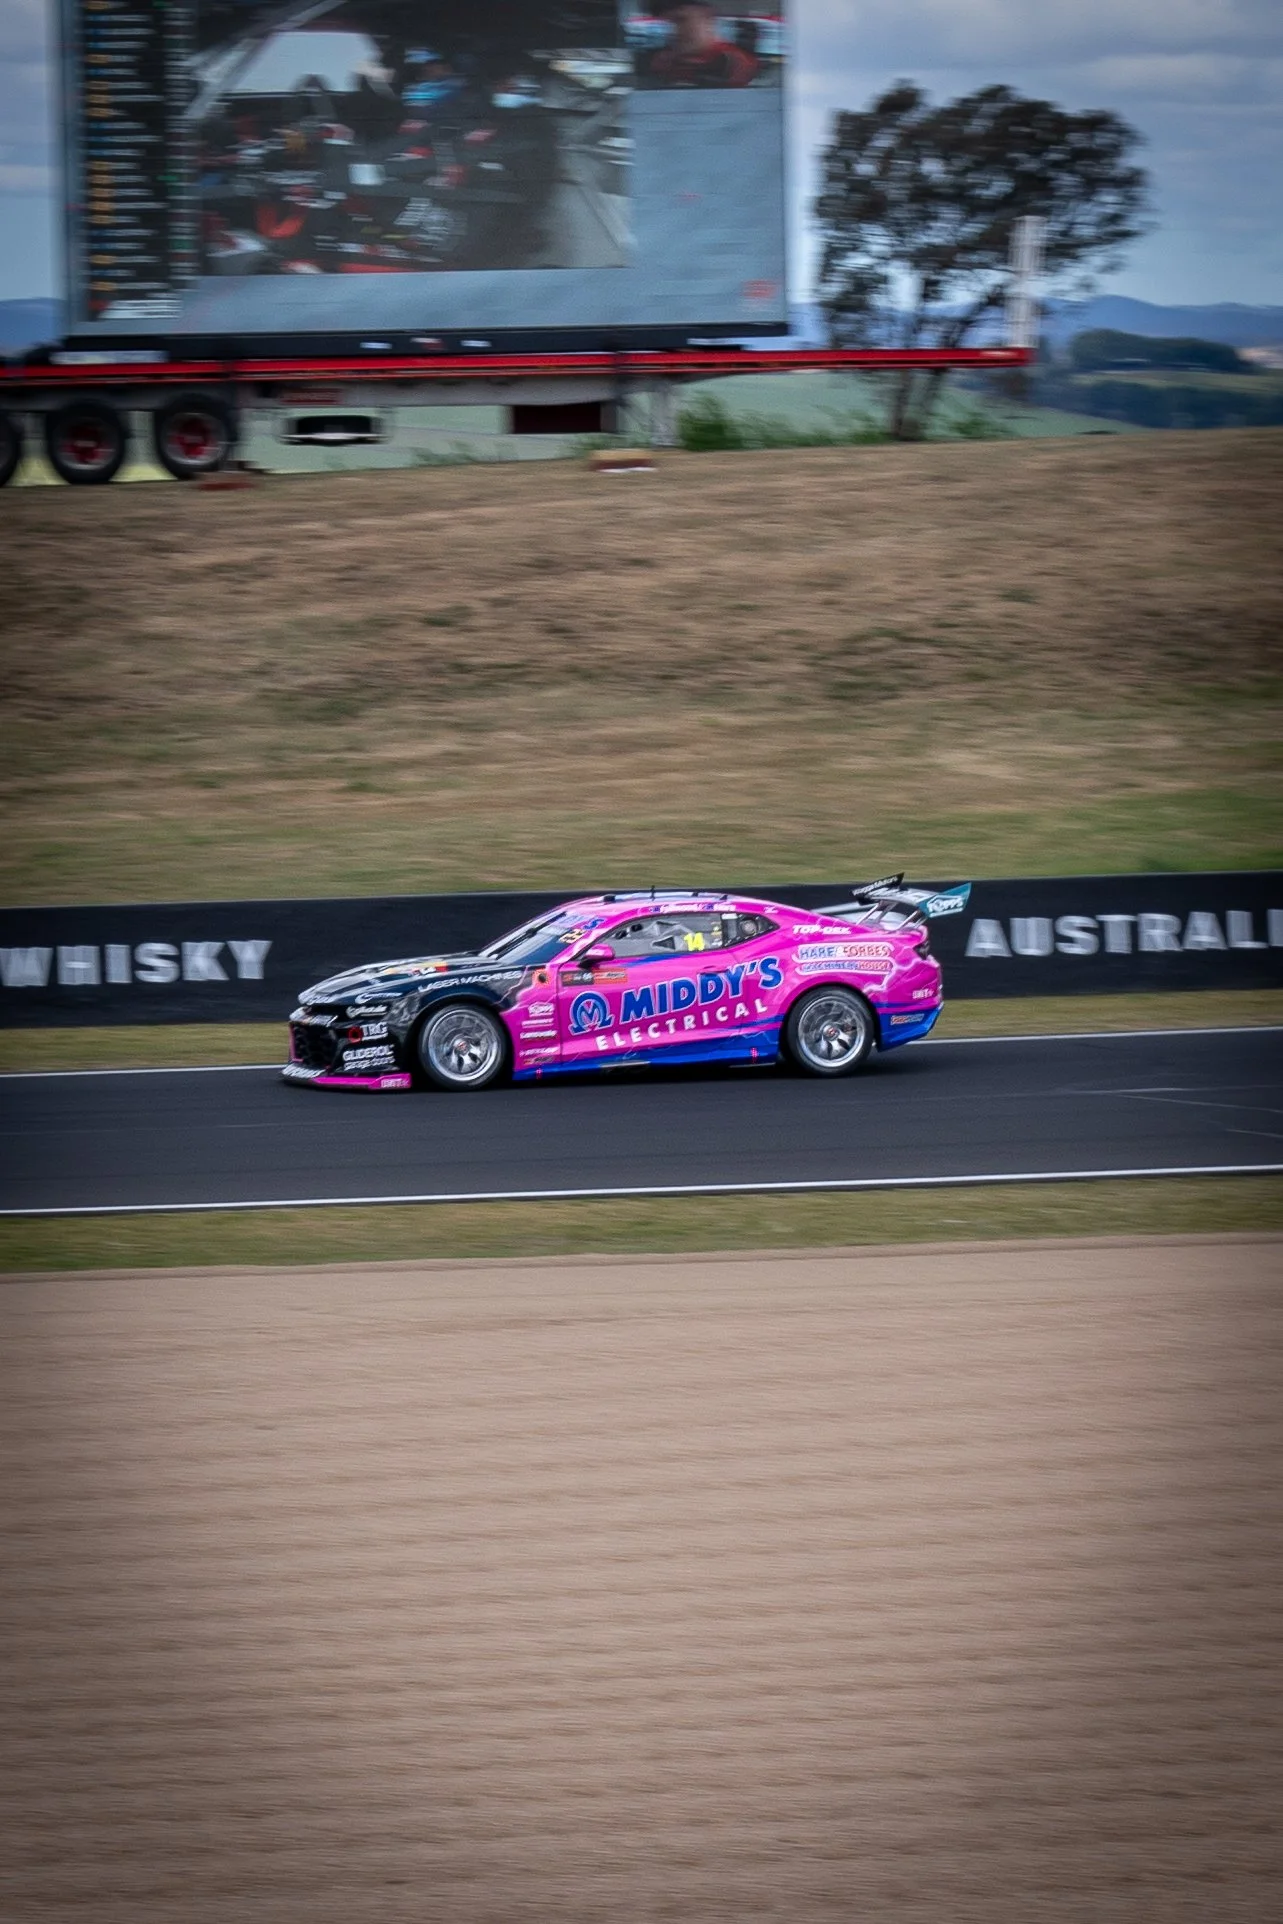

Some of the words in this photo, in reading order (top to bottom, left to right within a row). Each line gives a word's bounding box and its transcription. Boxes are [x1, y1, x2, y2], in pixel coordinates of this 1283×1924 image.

[0, 940, 273, 987] WHISKY
[684, 932, 705, 952] 14
[799, 946, 836, 960] HARE
[843, 945, 890, 958] FORBES
[619, 956, 784, 1024] MIDDY'S
[595, 997, 768, 1051] ELECTRICAL
